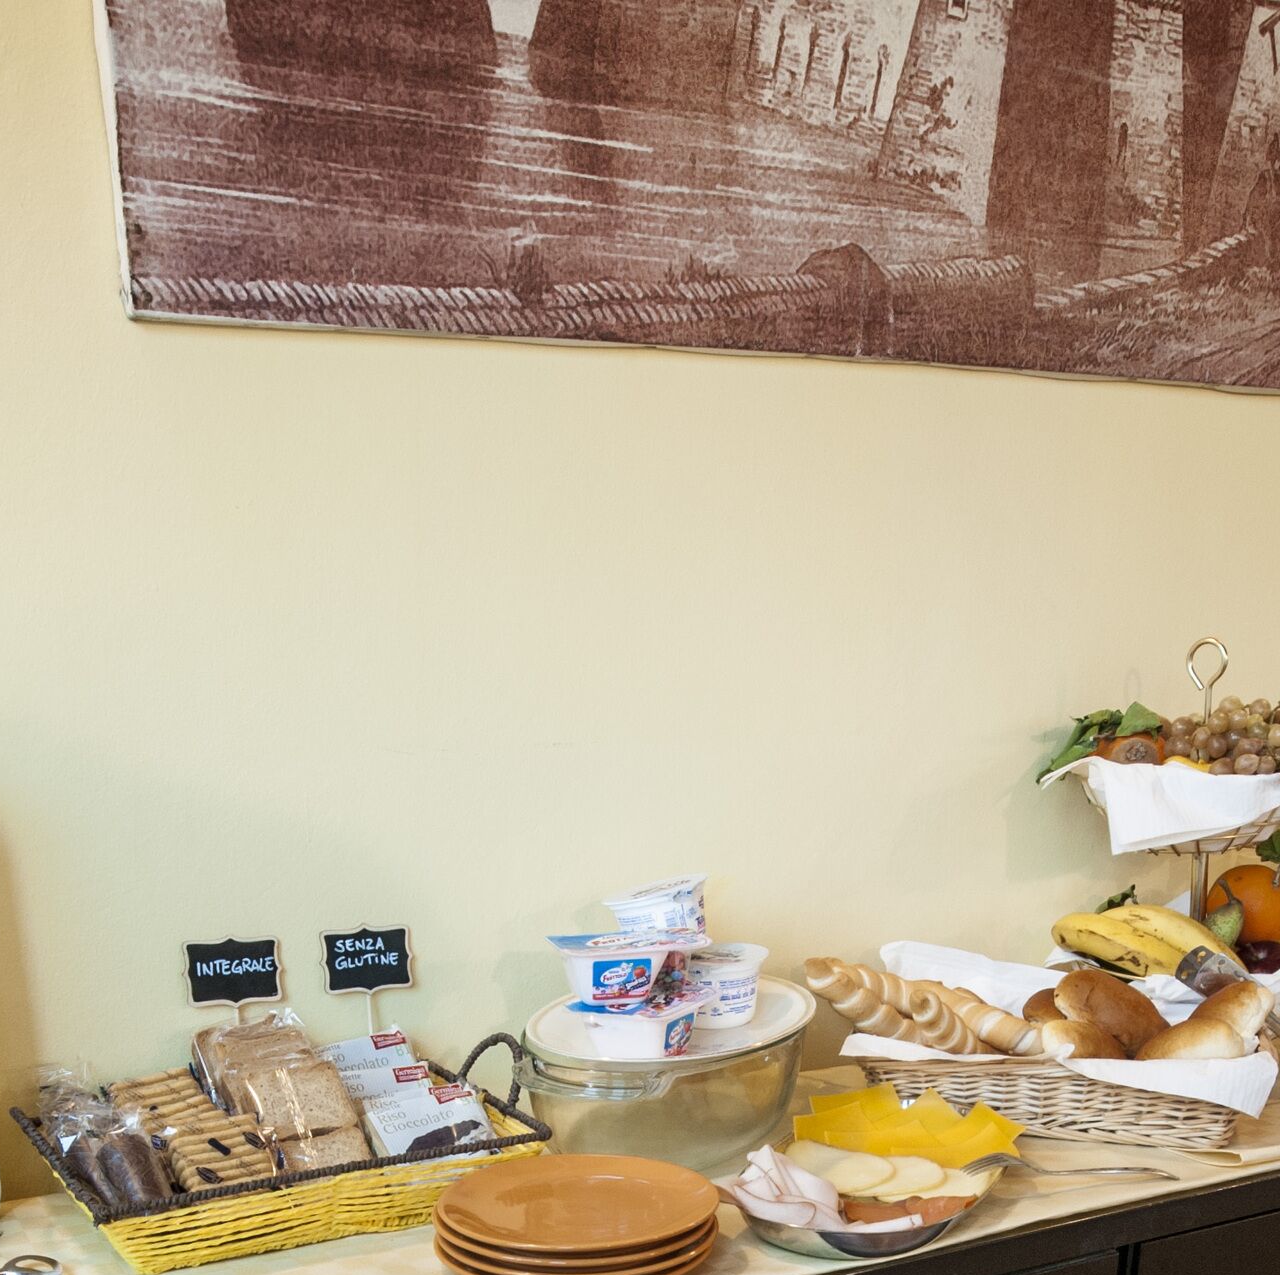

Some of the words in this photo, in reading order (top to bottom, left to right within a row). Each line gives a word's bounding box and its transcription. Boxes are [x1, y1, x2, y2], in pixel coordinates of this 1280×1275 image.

[333, 936, 386, 954] SENZA
[196, 955, 275, 977] INTEGRALE
[345, 1081, 365, 1094] iso
[377, 1111, 408, 1126] Riso
[383, 1109, 455, 1137] Cioccolato
